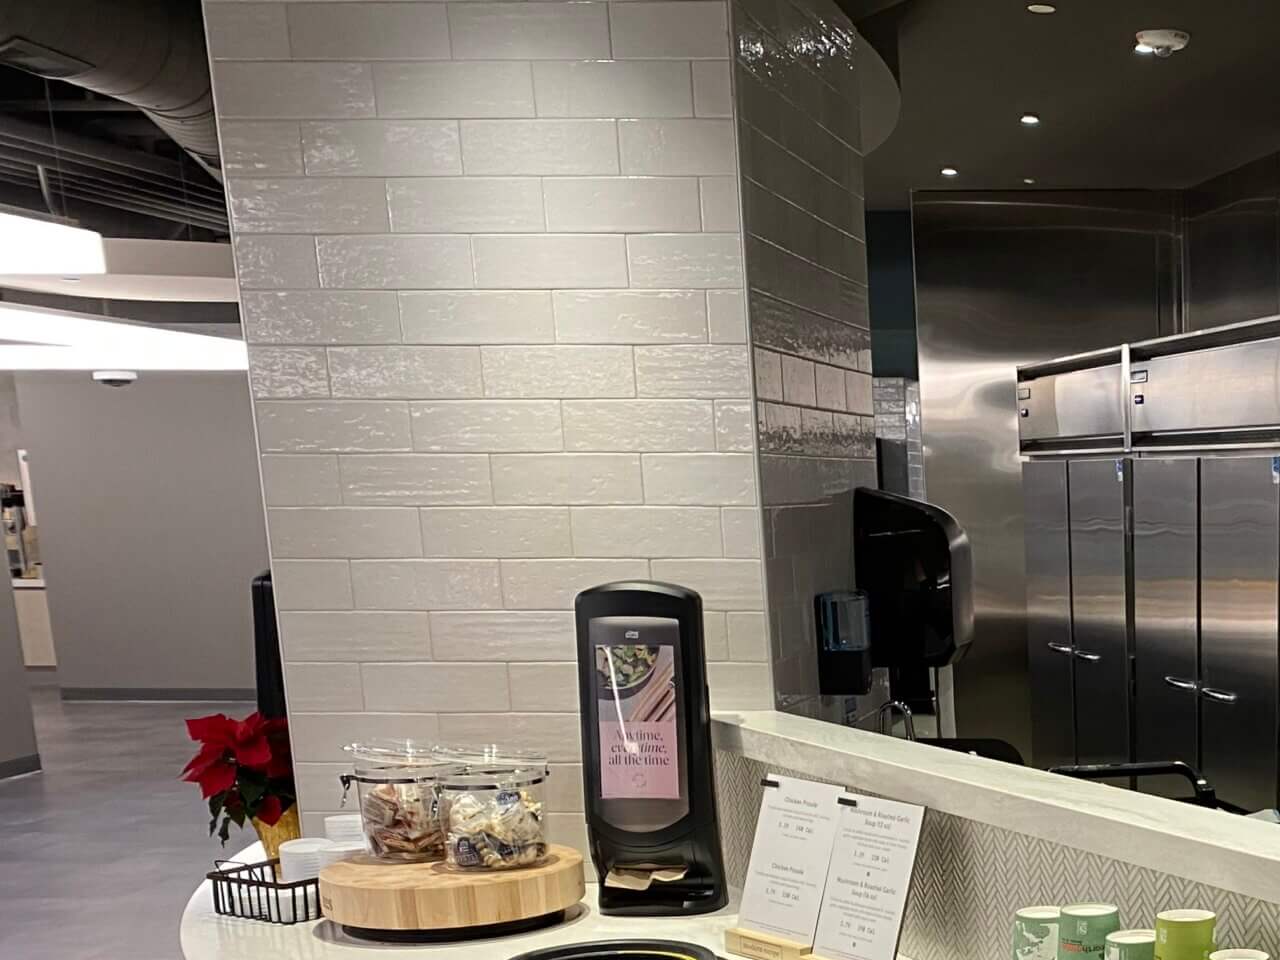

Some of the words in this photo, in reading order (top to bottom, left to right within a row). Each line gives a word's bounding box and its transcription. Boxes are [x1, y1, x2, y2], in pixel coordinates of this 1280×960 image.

[611, 743, 667, 756] evetime,
[609, 754, 621, 765] all
[624, 754, 641, 765] the
[644, 754, 669, 765] time
